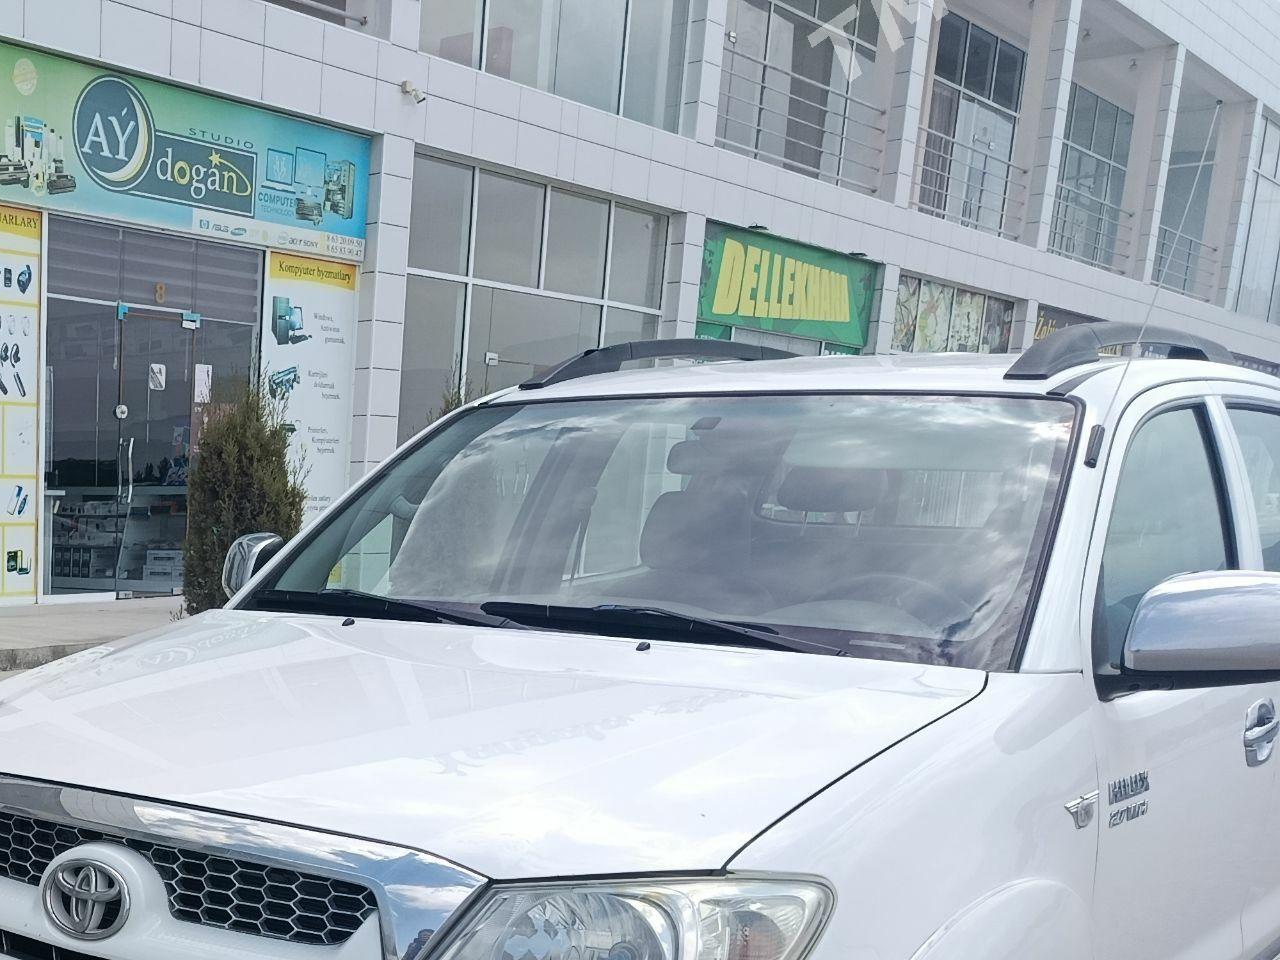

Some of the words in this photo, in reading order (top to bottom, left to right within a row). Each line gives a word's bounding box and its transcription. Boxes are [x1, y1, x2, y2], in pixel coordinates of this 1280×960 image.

[188, 127, 255, 149] STUDIO
[156, 147, 252, 199] dogan
[155, 282, 167, 303] 8
